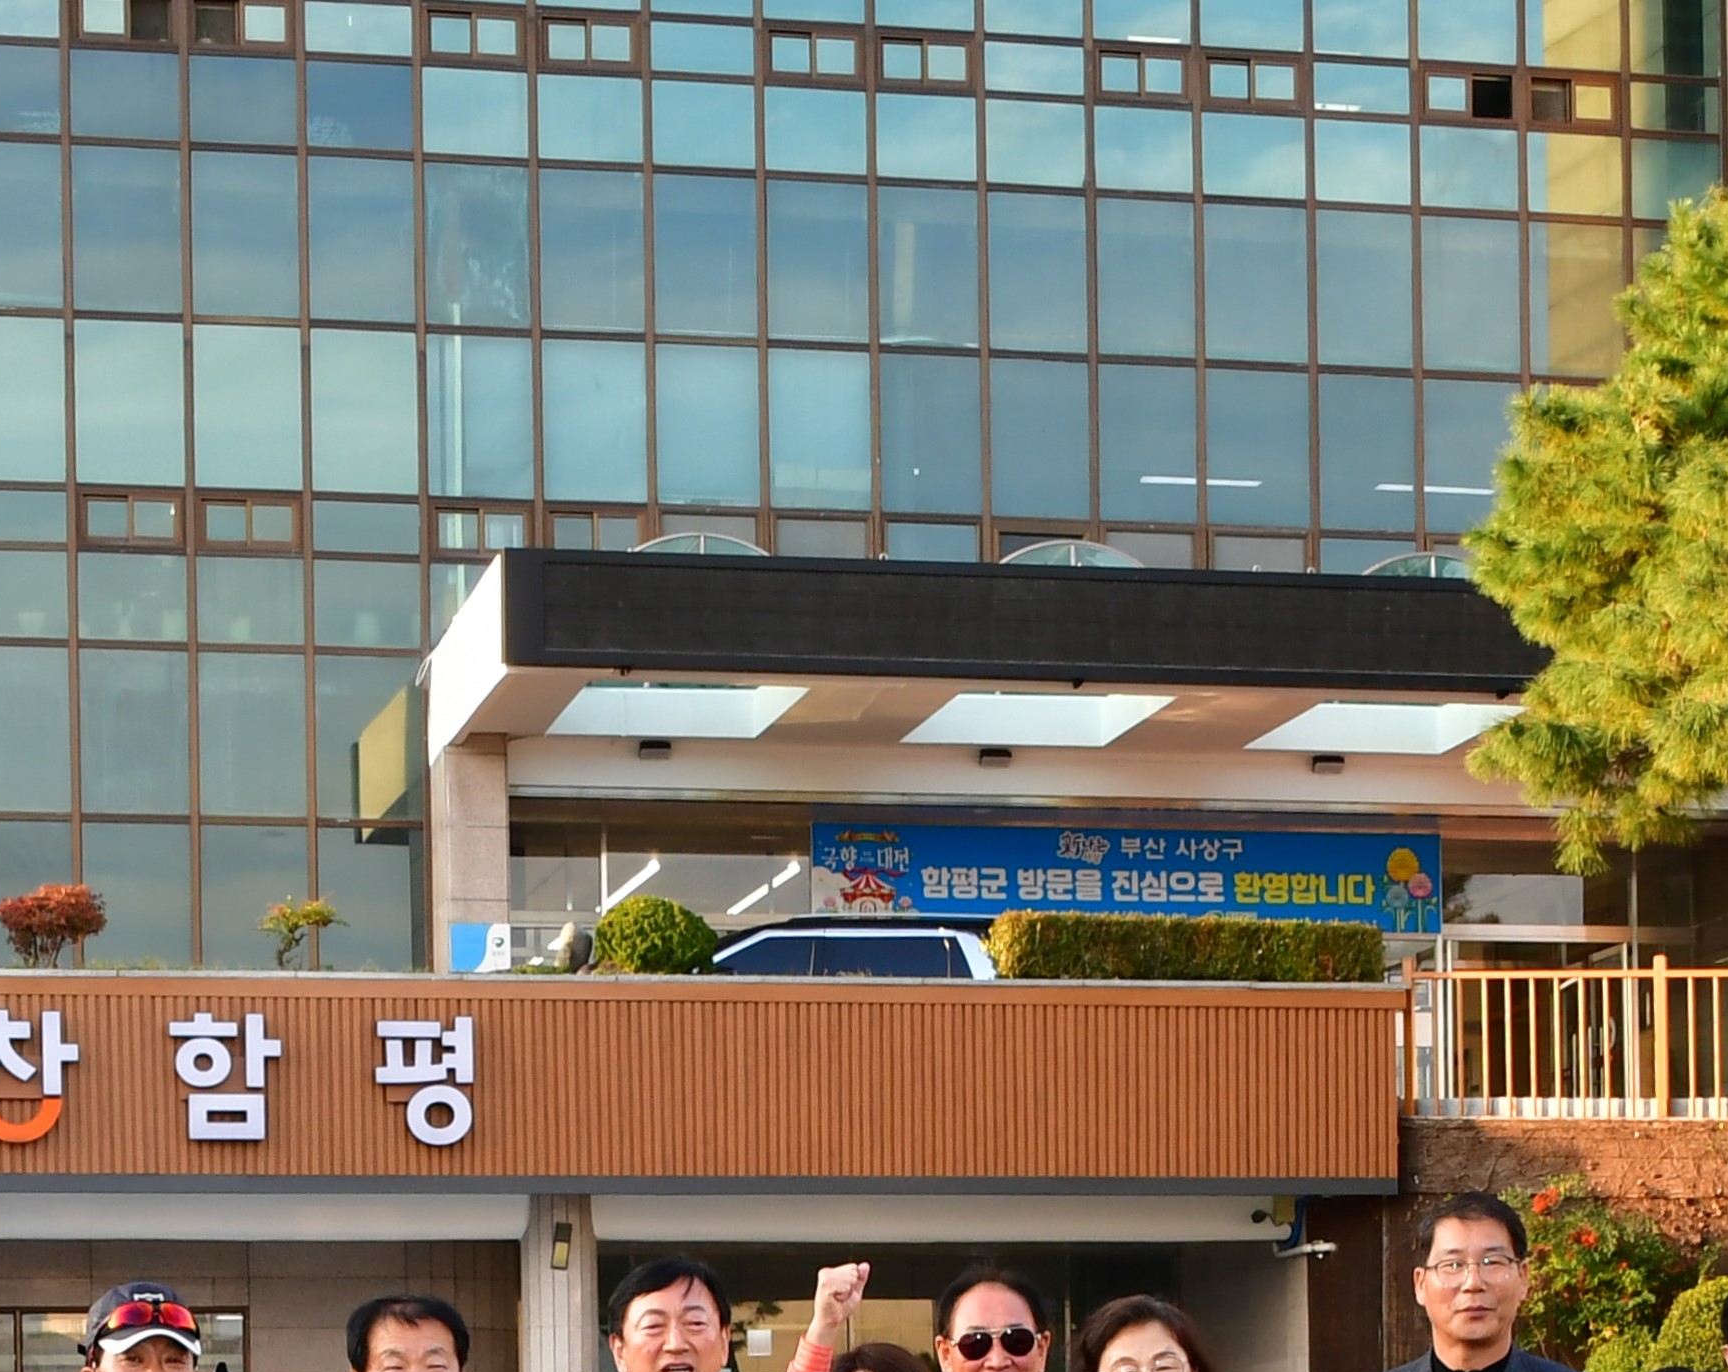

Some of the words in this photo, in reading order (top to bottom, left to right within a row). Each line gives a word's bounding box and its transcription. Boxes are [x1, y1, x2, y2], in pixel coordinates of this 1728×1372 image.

[1121, 836, 1166, 860] 부산
[1176, 837, 1243, 861] 사상구
[921, 866, 1008, 900] 함평군
[1017, 868, 1101, 902] 방문을
[1111, 870, 1226, 903] 진심으로
[1233, 872, 1376, 905] 환영합니다
